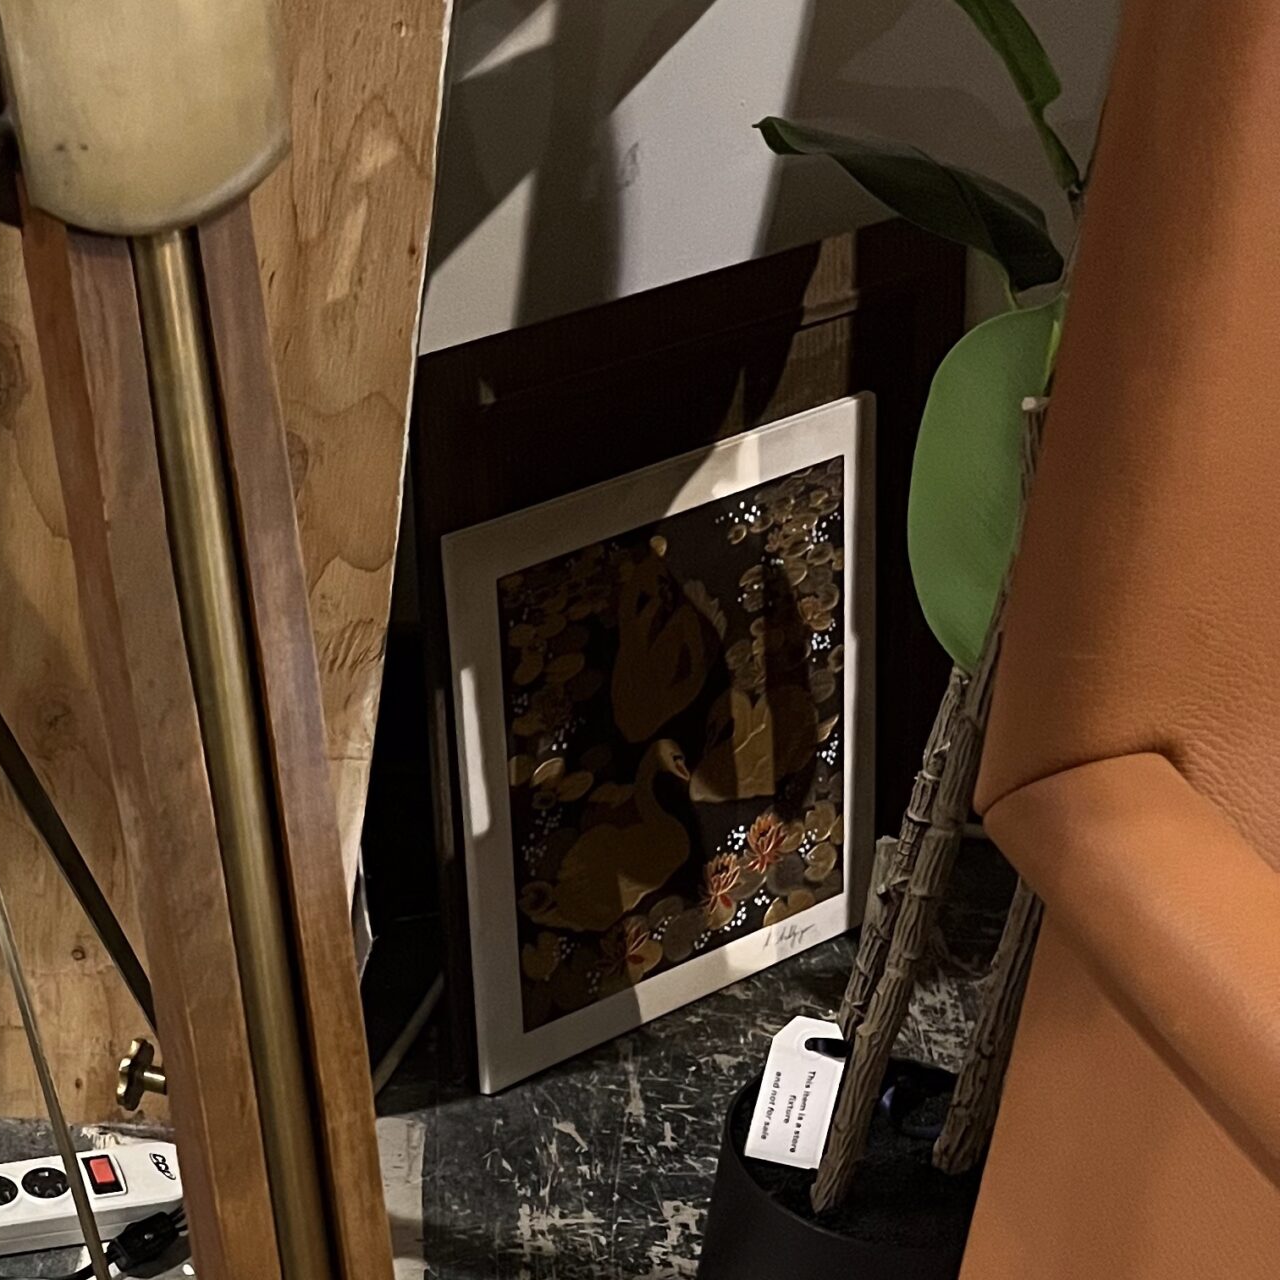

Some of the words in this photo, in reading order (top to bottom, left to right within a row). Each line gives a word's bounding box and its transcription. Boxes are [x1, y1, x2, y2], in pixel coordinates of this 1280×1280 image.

[772, 1071, 782, 1088] and
[804, 1071, 817, 1088] This
[769, 1090, 777, 1105] not
[800, 1091, 811, 1111] item
[766, 1107, 774, 1120] for
[783, 1095, 796, 1124] fixture
[761, 1122, 769, 1140] sale
[789, 1130, 800, 1153] store
